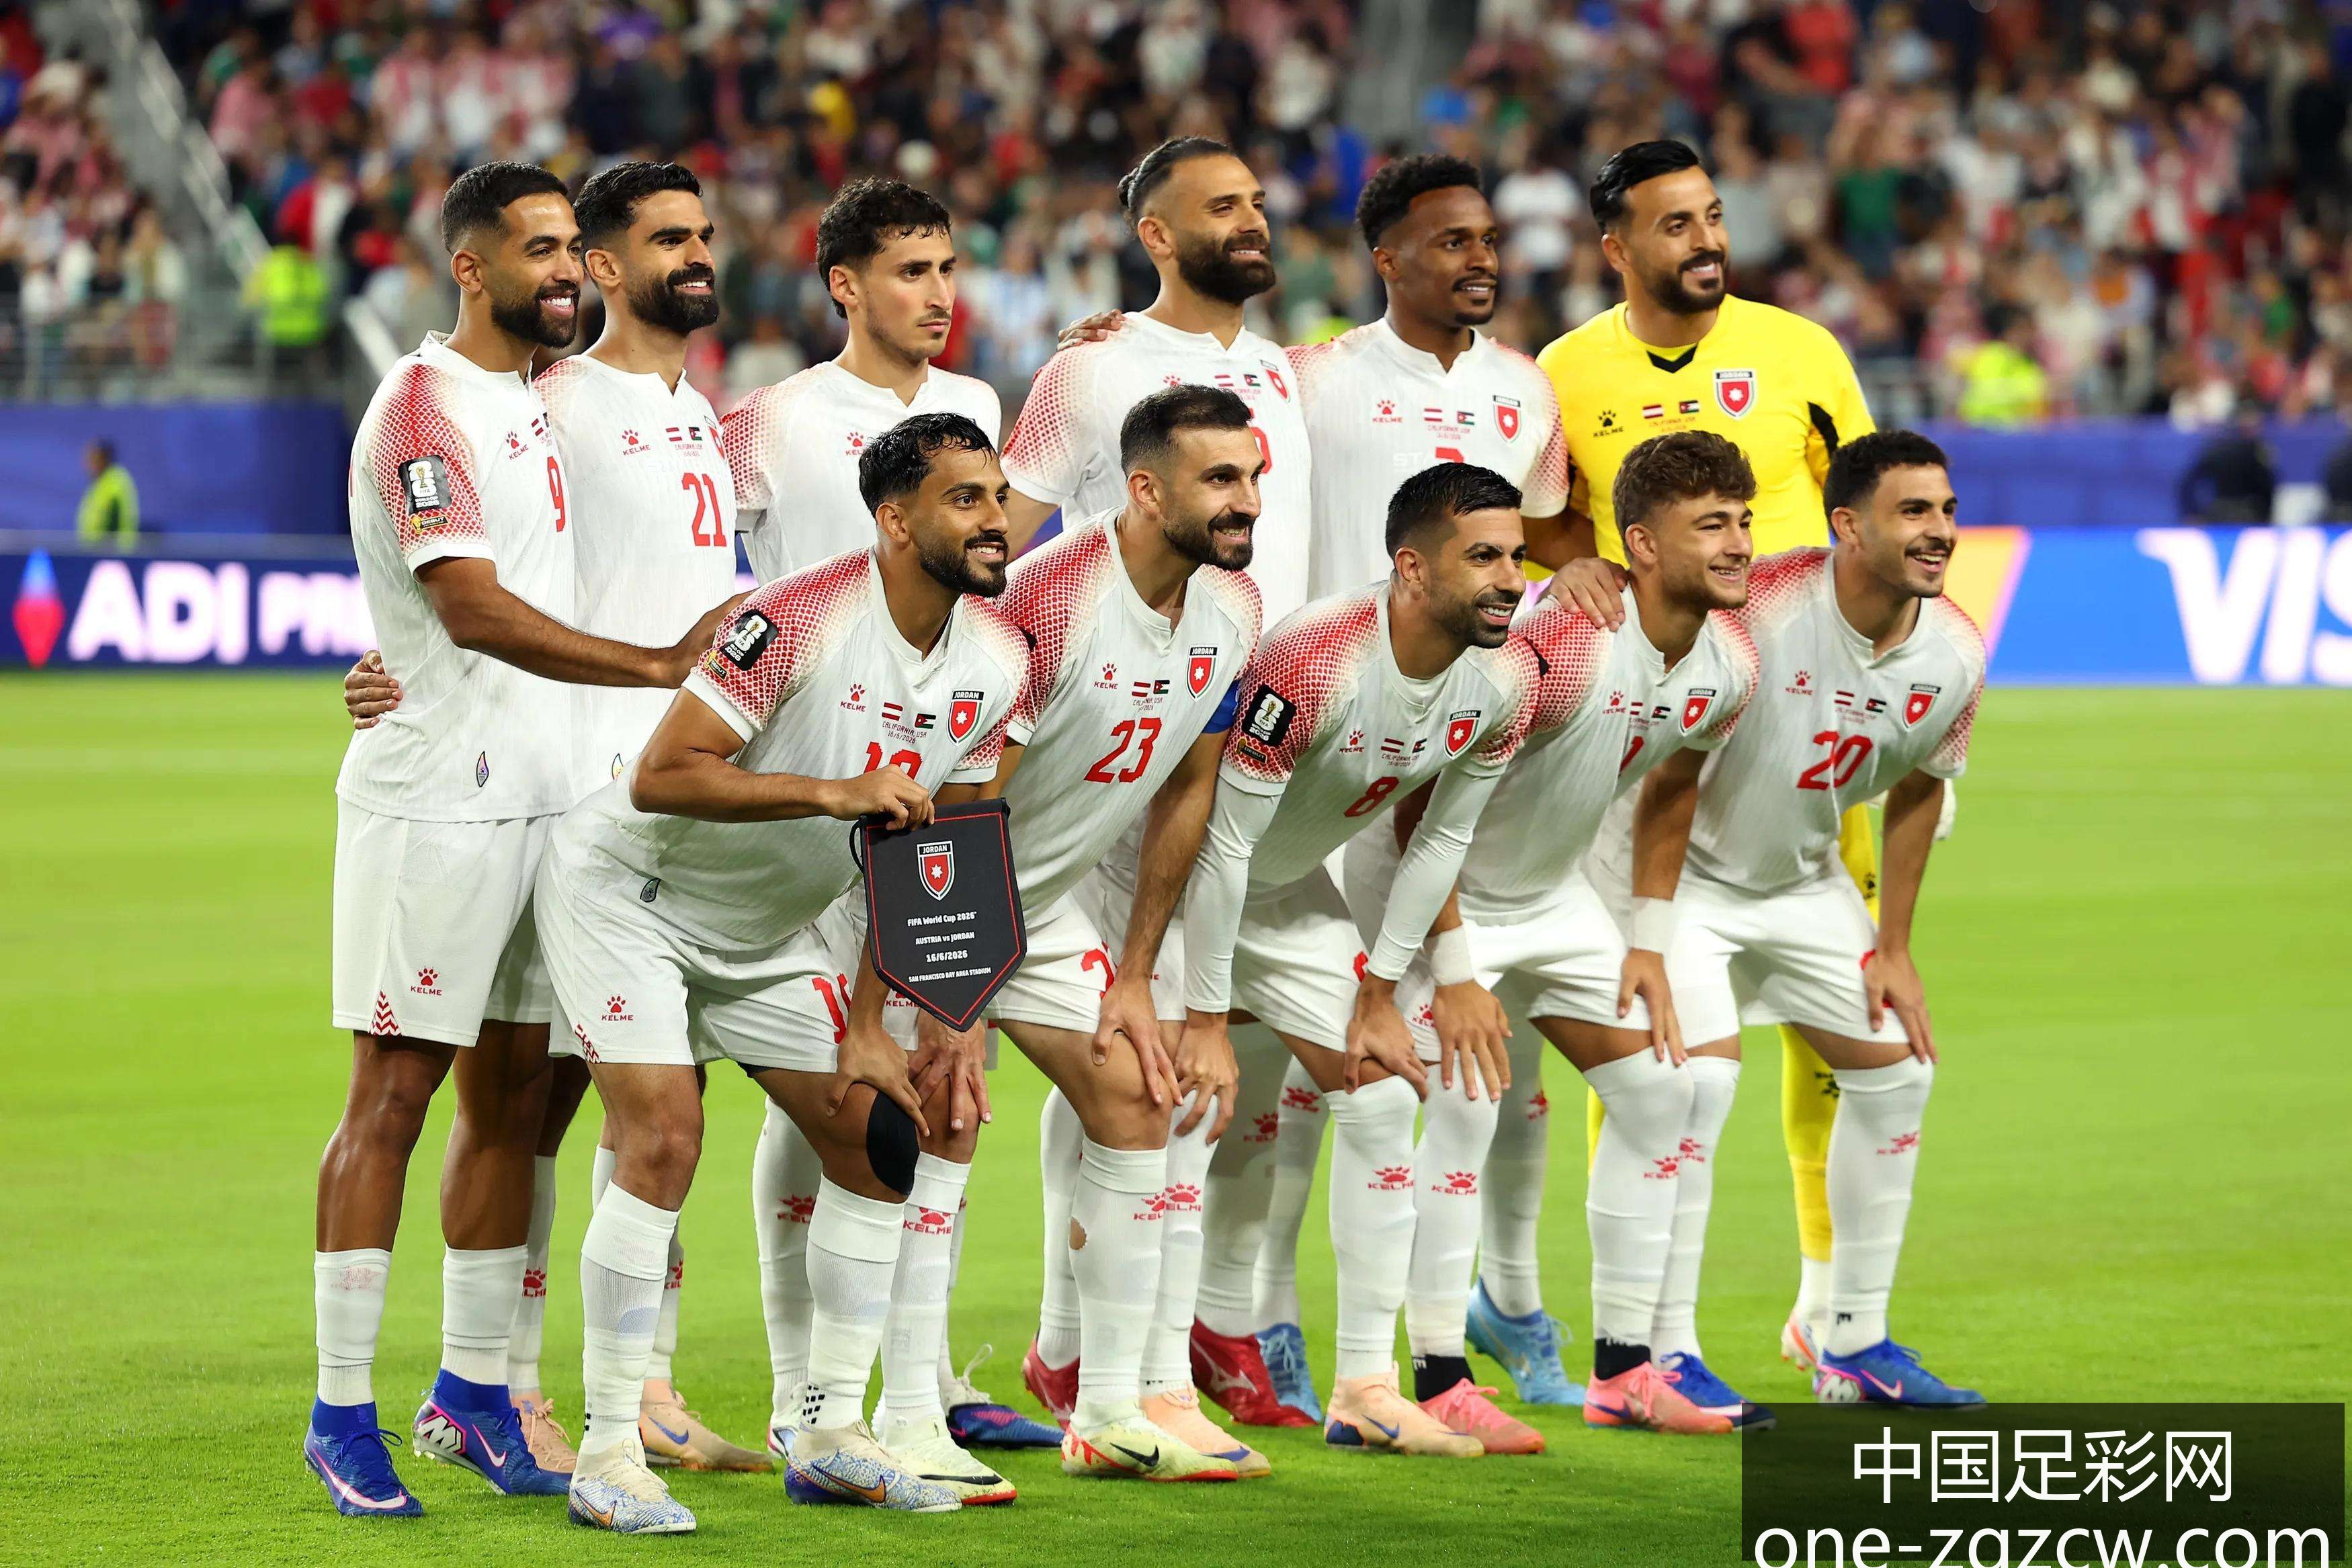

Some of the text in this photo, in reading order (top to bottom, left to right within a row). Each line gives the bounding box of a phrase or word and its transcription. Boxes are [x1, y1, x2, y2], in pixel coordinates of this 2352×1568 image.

[509, 444, 530, 461] KELME
[623, 444, 650, 455] KELME
[546, 455, 566, 532] 9
[682, 472, 727, 548] 21
[421, 517, 445, 526] DEBUT
[68, 560, 249, 664] ADI
[1093, 681, 1118, 689] KELME
[954, 691, 980, 699] JORDAN
[840, 701, 866, 712] KELME
[1452, 711, 1477, 720] JORDAN
[882, 722, 915, 738] CALIFORNIA,
[888, 730, 916, 744] 16/6/2026
[1249, 727, 1269, 741] 2026
[1083, 717, 1162, 783] 23
[1796, 730, 1874, 791] 20
[1343, 777, 1400, 818] 8
[922, 844, 948, 854] JORDAN
[907, 918, 923, 926] FIFA
[923, 915, 943, 925] World
[943, 914, 956, 923] Cup
[915, 935, 942, 945] AUSTRIA
[950, 931, 975, 942] JORDAN
[926, 950, 968, 963] 16/6/2026
[919, 972, 946, 982] FRANCISCO
[969, 967, 992, 975] STADIUM
[411, 986, 442, 996] KELME
[903, 1220, 952, 1235] KELME
